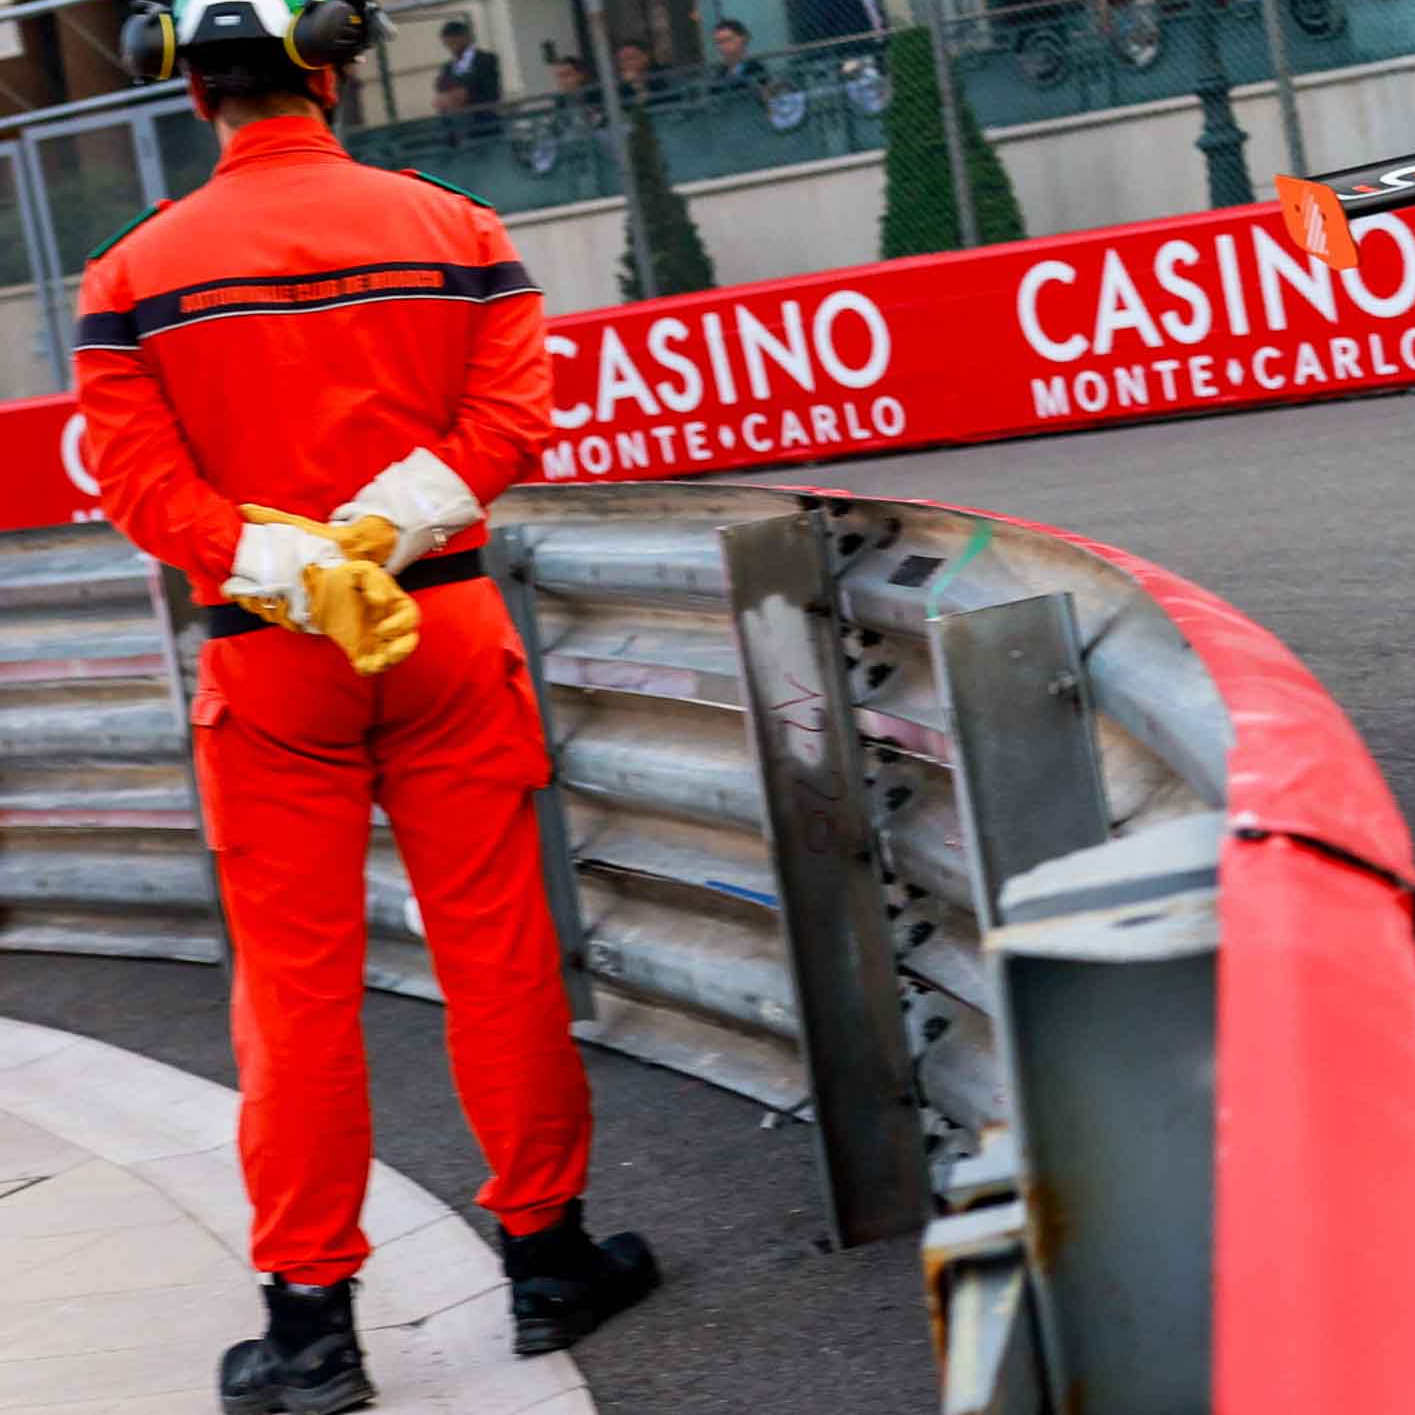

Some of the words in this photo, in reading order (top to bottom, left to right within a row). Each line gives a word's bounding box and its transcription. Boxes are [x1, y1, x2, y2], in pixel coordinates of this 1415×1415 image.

[544, 289, 892, 429] CASINO
[1031, 355, 1214, 419] MONTE
[542, 421, 713, 479] MONTE
[743, 396, 905, 452] CARLO
